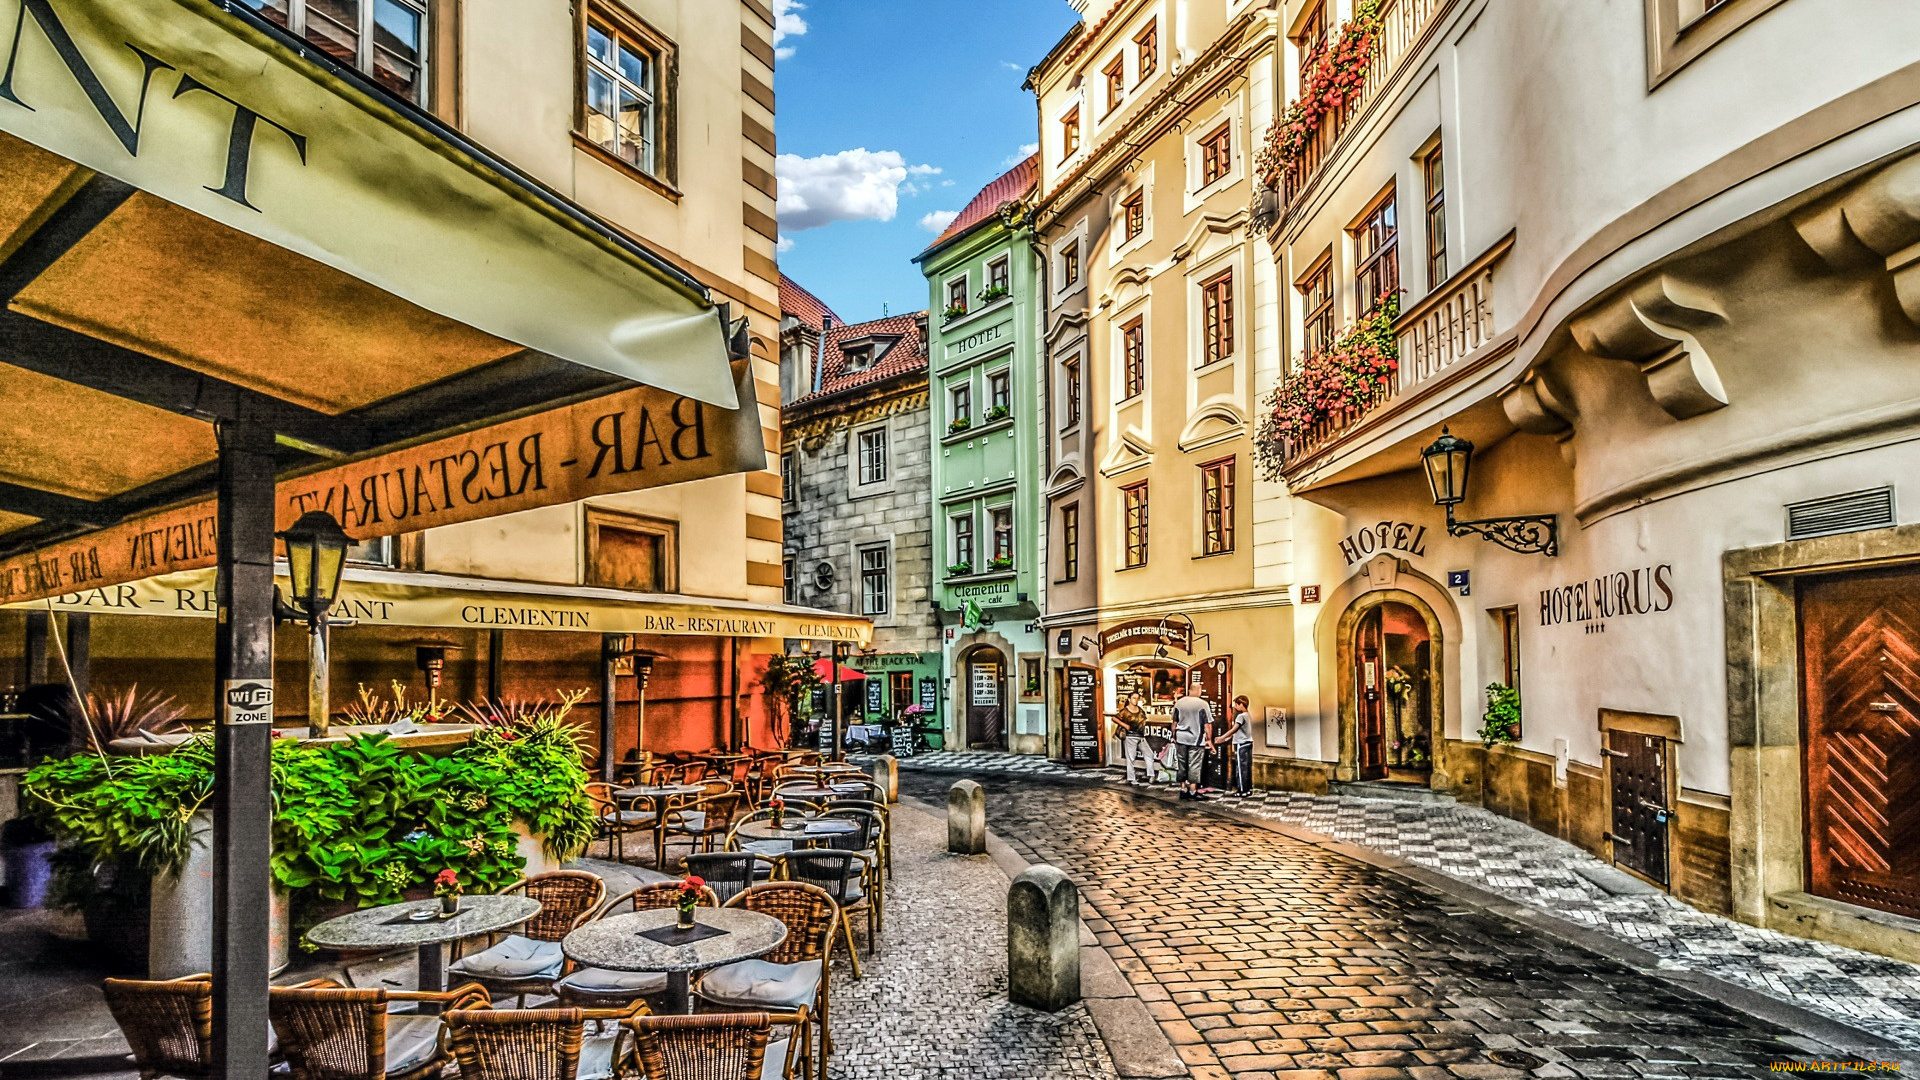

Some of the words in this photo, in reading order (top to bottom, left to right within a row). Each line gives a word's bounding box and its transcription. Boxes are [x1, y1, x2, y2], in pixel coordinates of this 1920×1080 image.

[958, 327, 1001, 352] HOTEL
[1338, 520, 1427, 566] HOTEL
[1455, 574, 1462, 583] 2
[954, 583, 1010, 598] Clementin
[1304, 586, 1316, 595] 175
[1540, 581, 1594, 626] HOTEL
[1594, 564, 1673, 618] AURUS
[461, 605, 590, 628] CLEMENTIN
[644, 615, 675, 631] BAR
[687, 617, 775, 635] RESTAURANT
[799, 624, 860, 639] CLEMENTIN
[1132, 626, 1141, 636] ICE
[1141, 626, 1160, 636] CREAM
[855, 658, 863, 666] AT
[865, 658, 879, 666] THE
[881, 657, 904, 665] BLACK
[905, 656, 925, 665] STAR
[235, 713, 267, 722] ZONE
[1150, 726, 1162, 737] ICE
